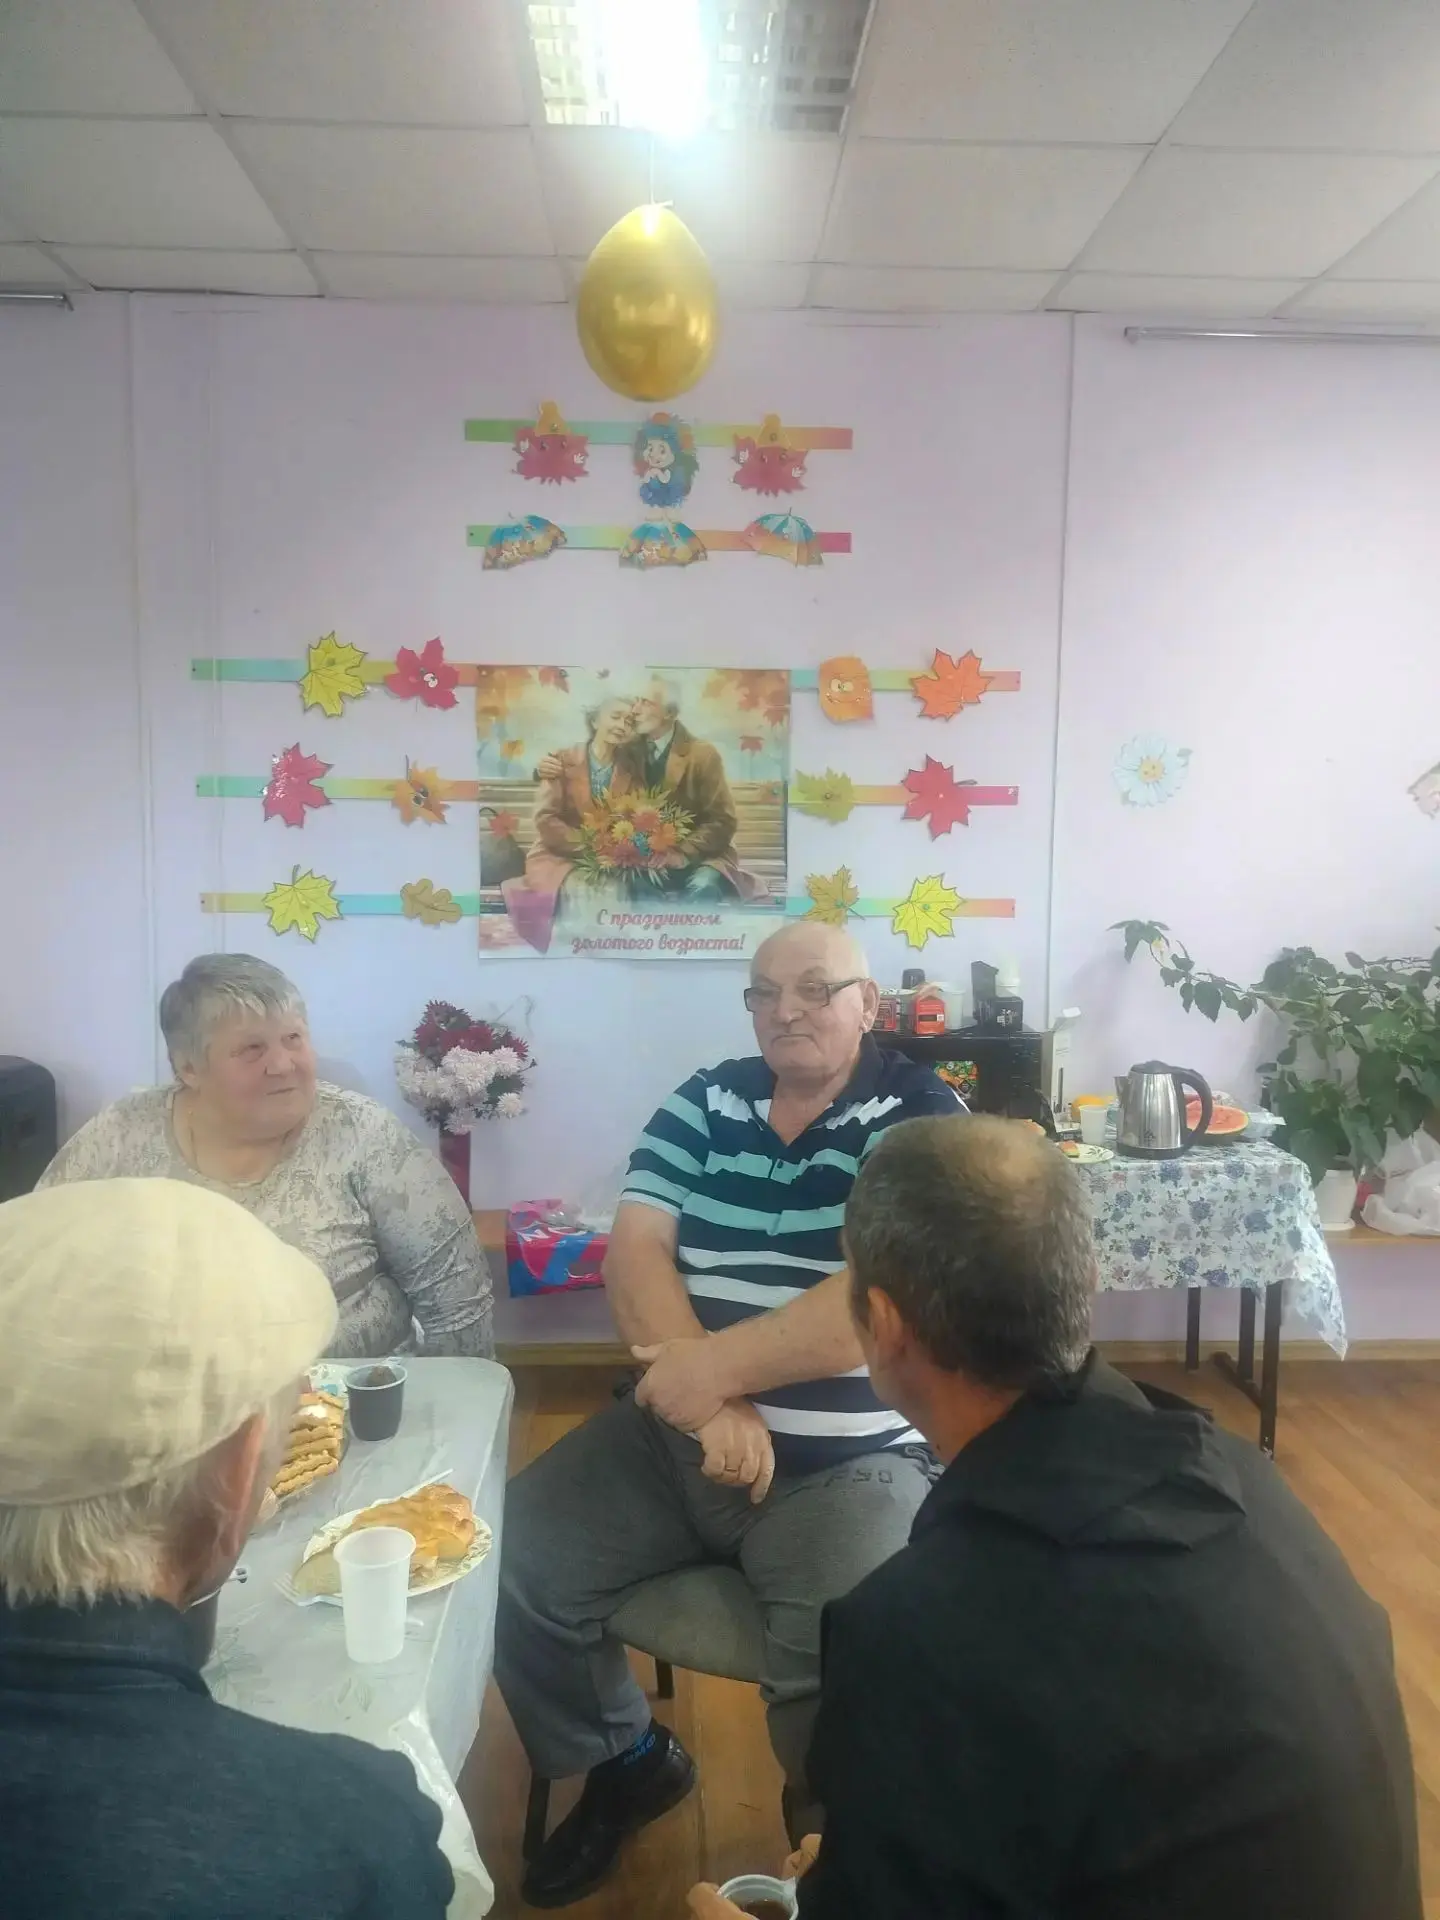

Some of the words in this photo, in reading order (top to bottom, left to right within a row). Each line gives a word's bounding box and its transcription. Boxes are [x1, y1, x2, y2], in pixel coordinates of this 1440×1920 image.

[597, 909, 608, 925] С
[611, 912, 722, 930] праздником
[571, 936, 654, 953] золотого
[658, 933, 746, 954] возраста!
